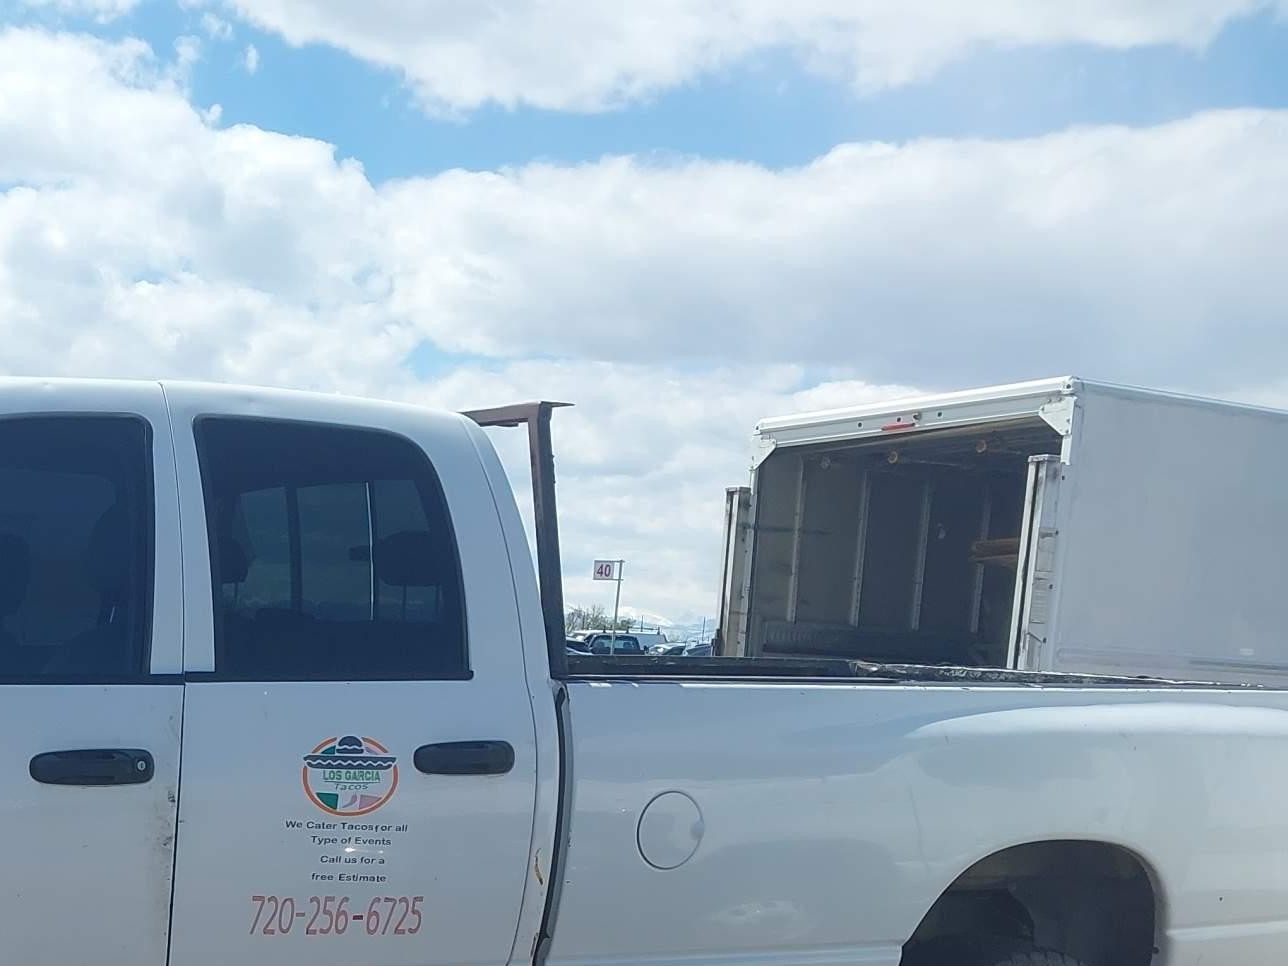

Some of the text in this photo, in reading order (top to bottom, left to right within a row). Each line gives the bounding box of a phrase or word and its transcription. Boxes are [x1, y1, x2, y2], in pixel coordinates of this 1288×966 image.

[596, 563, 611, 578] 40
[323, 770, 381, 782] LOS GARCIA
[336, 783, 369, 791] Tacos
[285, 820, 303, 829] We
[306, 821, 338, 830] Cater
[395, 824, 409, 832] all
[311, 835, 392, 846] Type of Events
[320, 855, 342, 864] Call
[360, 856, 377, 865] for
[311, 872, 387, 883] free Estimate
[249, 895, 424, 936] 720-256-6725
